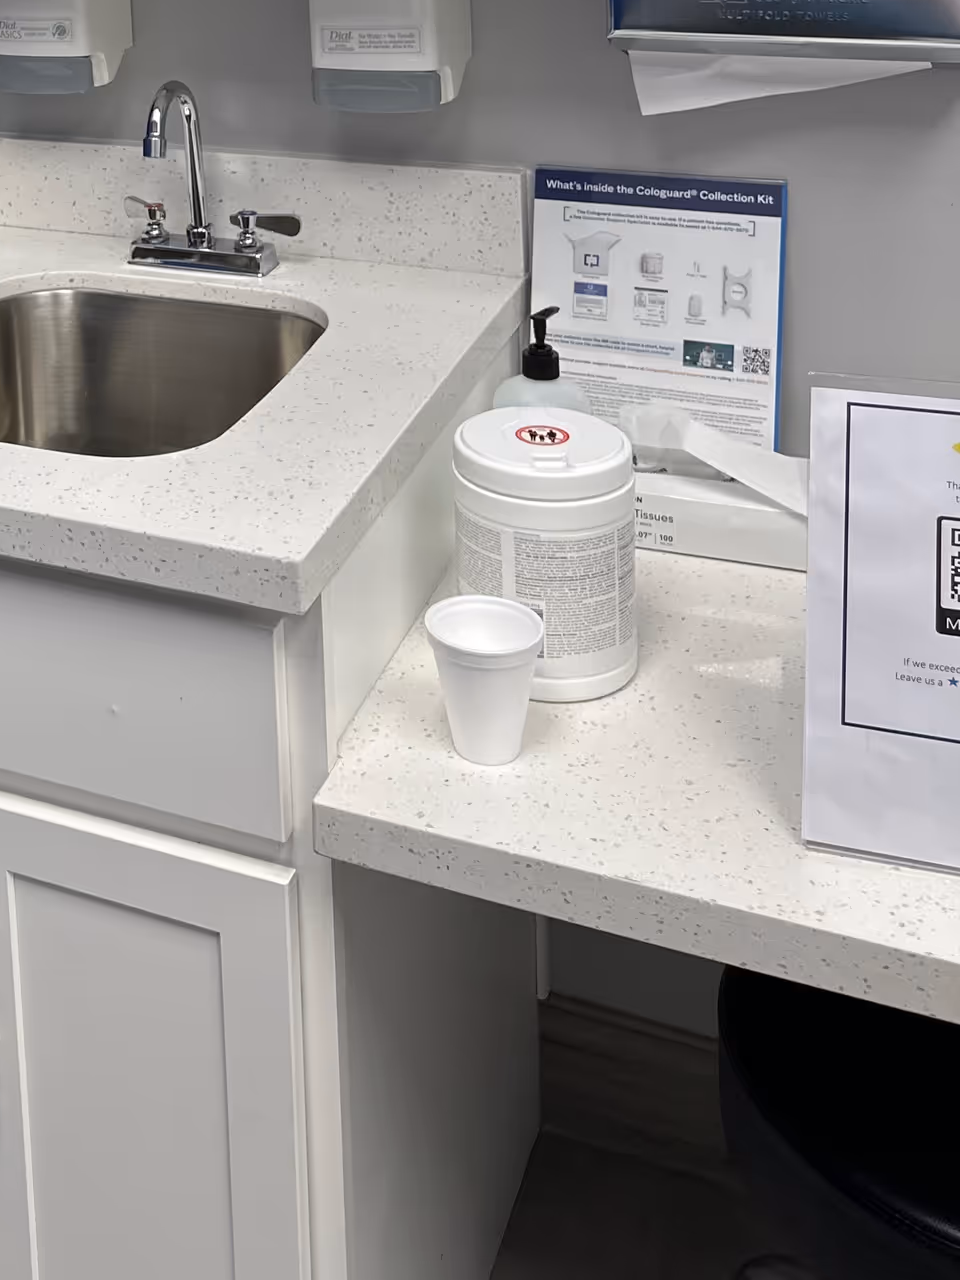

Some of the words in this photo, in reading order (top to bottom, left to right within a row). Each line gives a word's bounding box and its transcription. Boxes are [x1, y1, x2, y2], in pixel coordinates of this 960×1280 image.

[546, 179, 582, 191] What's
[584, 181, 614, 193] inside
[616, 184, 634, 195] the
[699, 190, 755, 203] Collection
[757, 194, 774, 204] Kit
[634, 508, 674, 523] Tissues
[659, 534, 674, 543] 100
[903, 657, 910, 666] If
[912, 660, 926, 669] we
[895, 672, 922, 683] Leave
[924, 677, 935, 685] us
[937, 679, 943, 687] a
